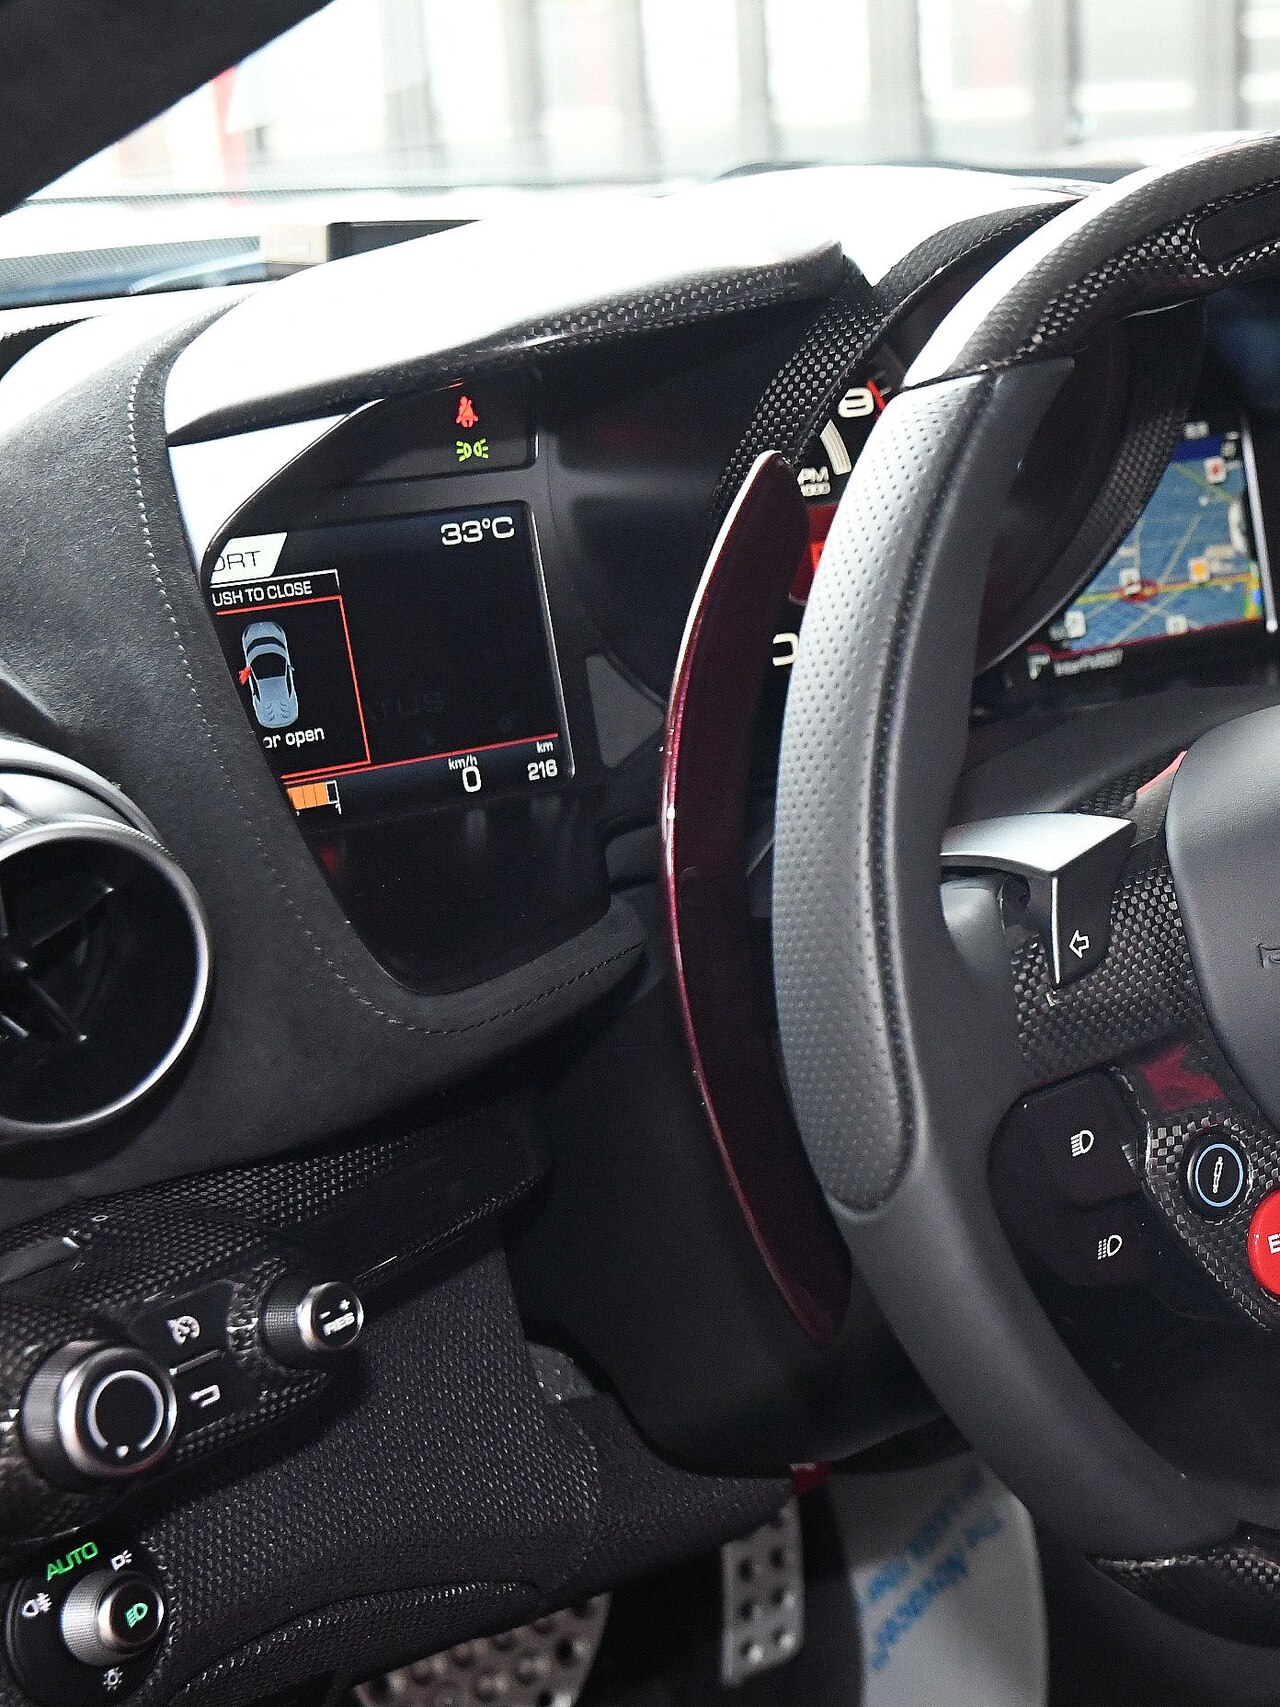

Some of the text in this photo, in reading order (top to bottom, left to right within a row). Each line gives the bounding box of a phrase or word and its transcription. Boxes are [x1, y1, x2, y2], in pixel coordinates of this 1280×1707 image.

[440, 516, 515, 546] 33°C
[212, 580, 313, 607] USH TO CLOSE
[285, 727, 325, 748] open
[537, 741, 554, 753] km
[448, 754, 478, 770] km/h
[527, 759, 558, 781] 216
[46, 1541, 98, 1581] AUTO
